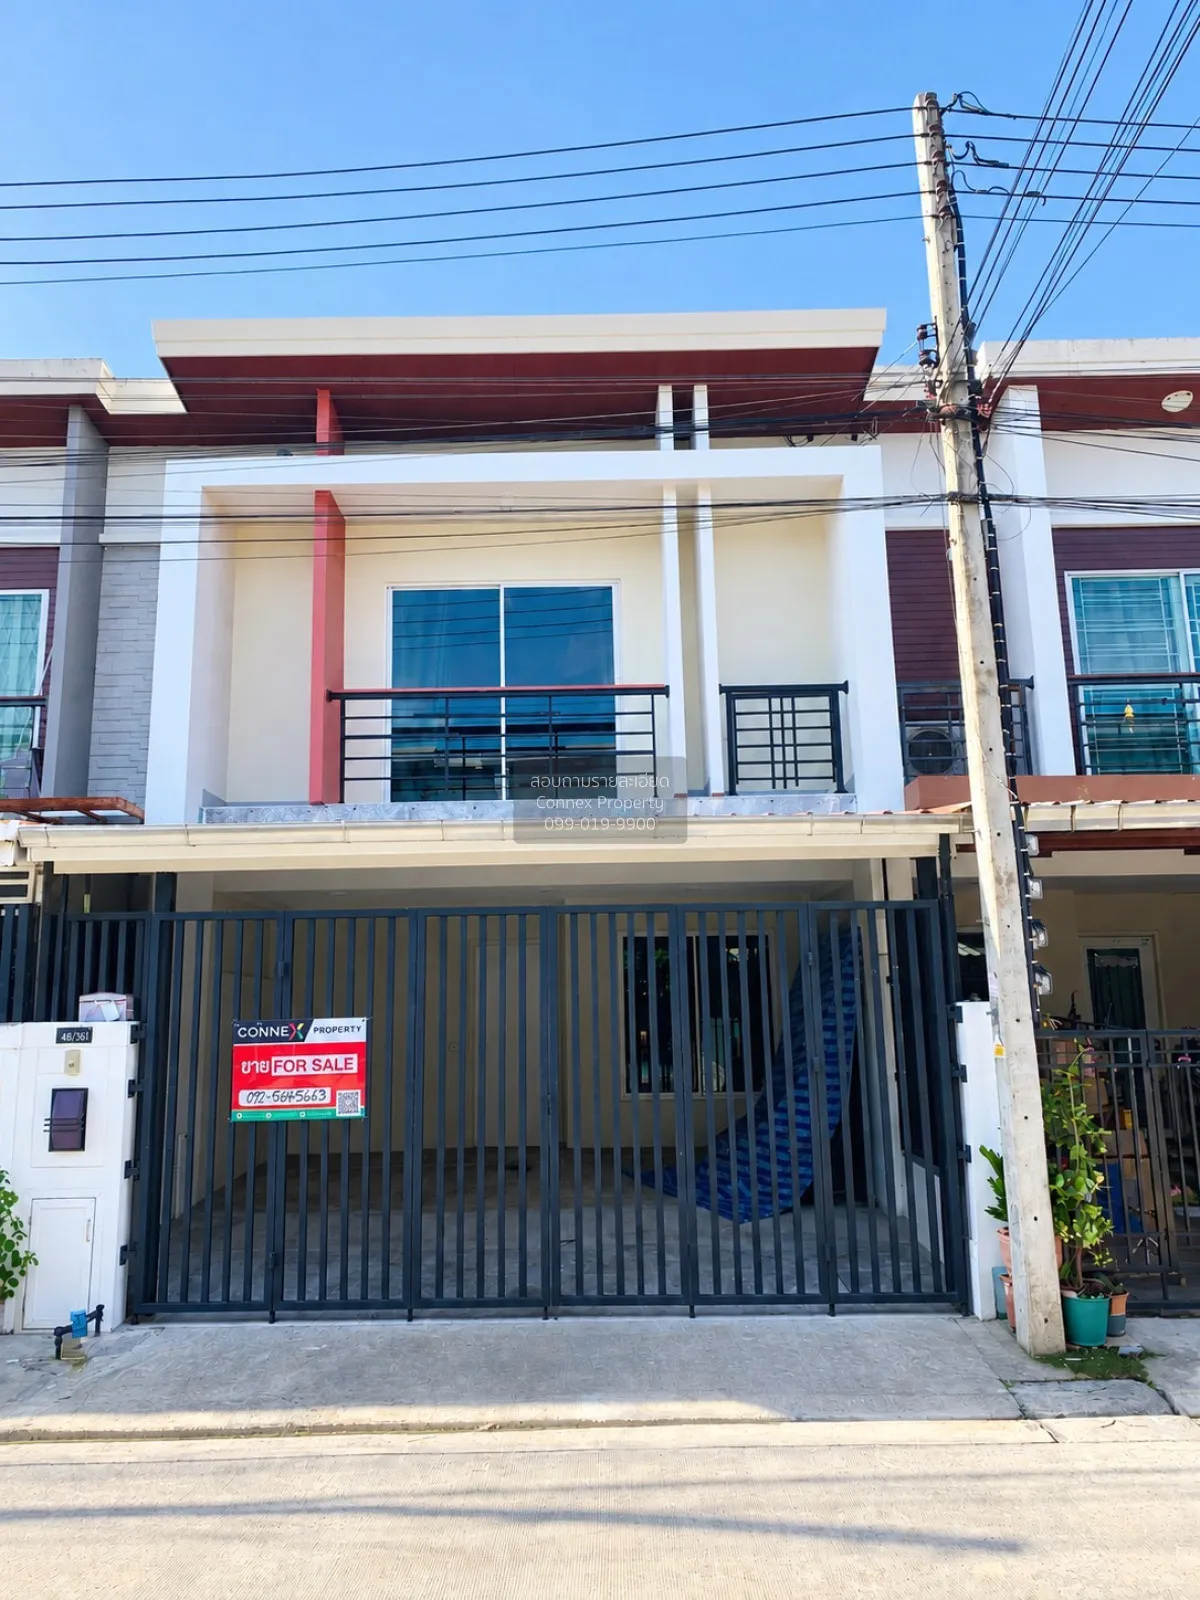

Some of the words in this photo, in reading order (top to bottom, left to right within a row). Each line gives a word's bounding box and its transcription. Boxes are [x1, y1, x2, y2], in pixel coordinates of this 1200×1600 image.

[237, 1022, 304, 1040] CONNEX
[313, 1025, 361, 1033] PROPERTY
[241, 1060, 270, 1074] ขาย
[273, 1059, 307, 1073] FOR
[312, 1057, 354, 1071] SALE
